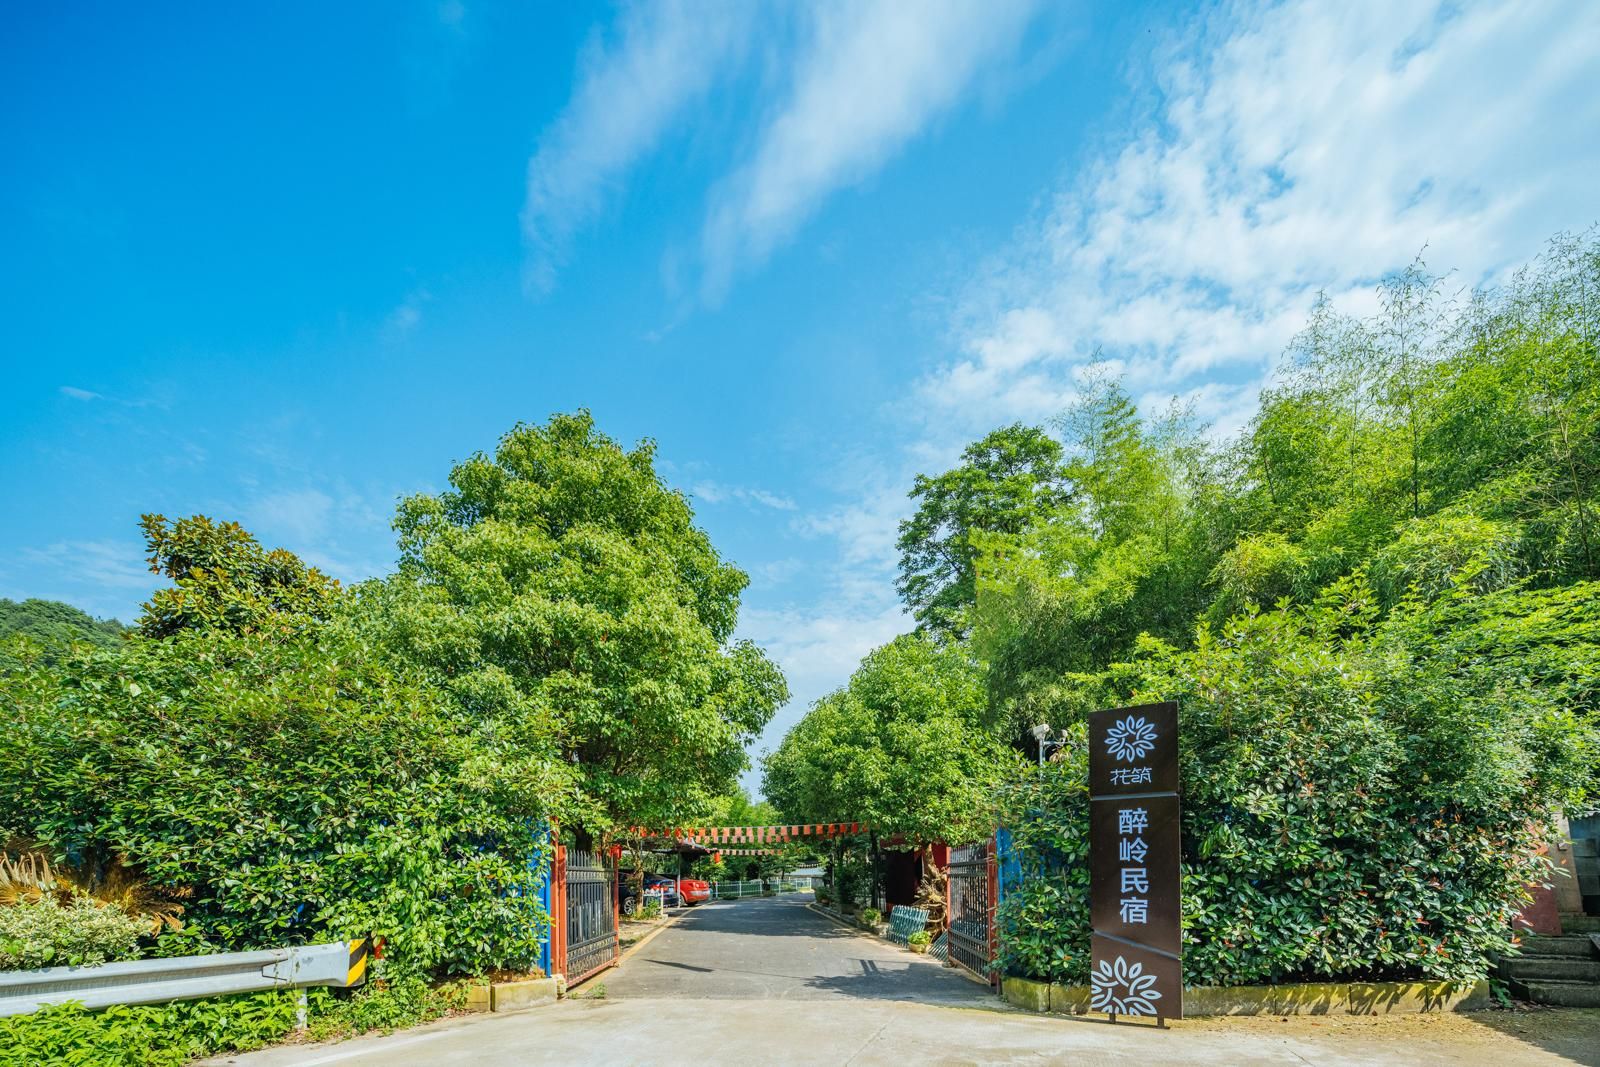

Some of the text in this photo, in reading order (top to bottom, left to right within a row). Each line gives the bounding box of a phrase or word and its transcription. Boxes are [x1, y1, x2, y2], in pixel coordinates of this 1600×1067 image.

[1110, 766, 1152, 785] 花筑
[1118, 807, 1149, 924] 醉岭民宿
